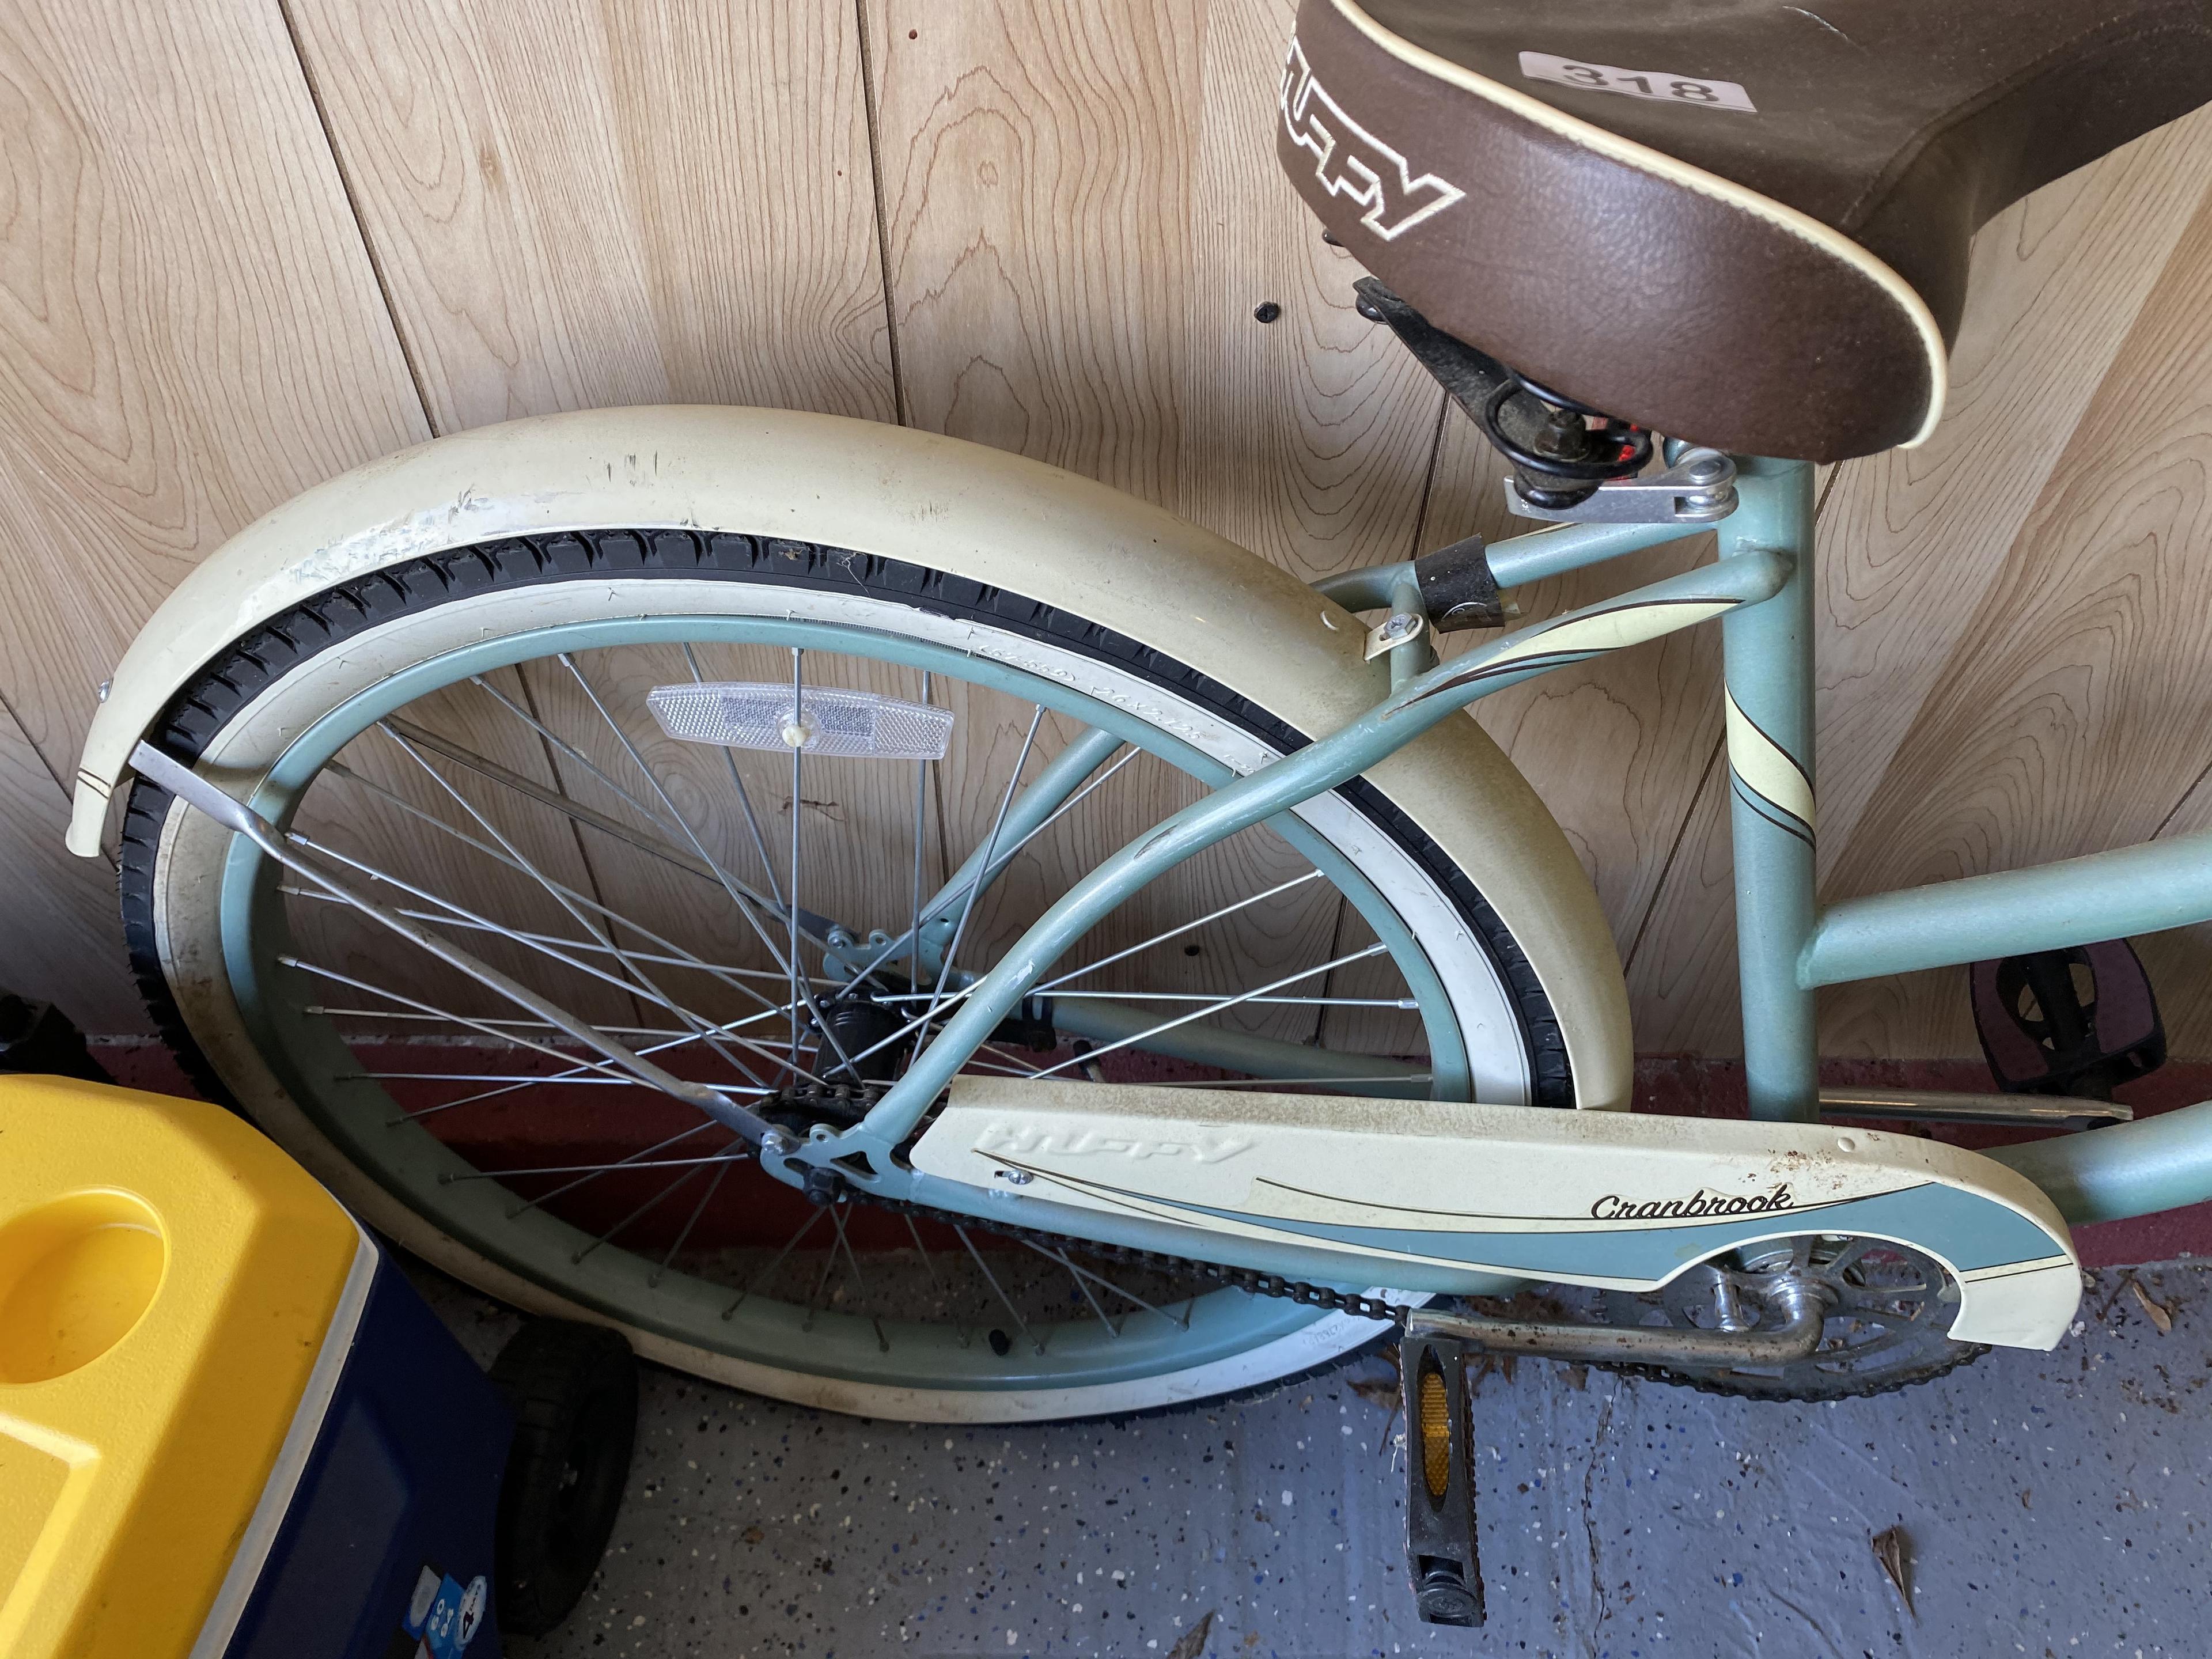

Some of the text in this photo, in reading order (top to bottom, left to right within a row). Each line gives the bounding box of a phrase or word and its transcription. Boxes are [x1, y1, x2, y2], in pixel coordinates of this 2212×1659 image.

[1562, 65, 1719, 102] 318
[1280, 23, 1467, 241] UFFY
[975, 1122, 1259, 1164] HUFFY
[1591, 1184, 1794, 1218] Cranbrook
